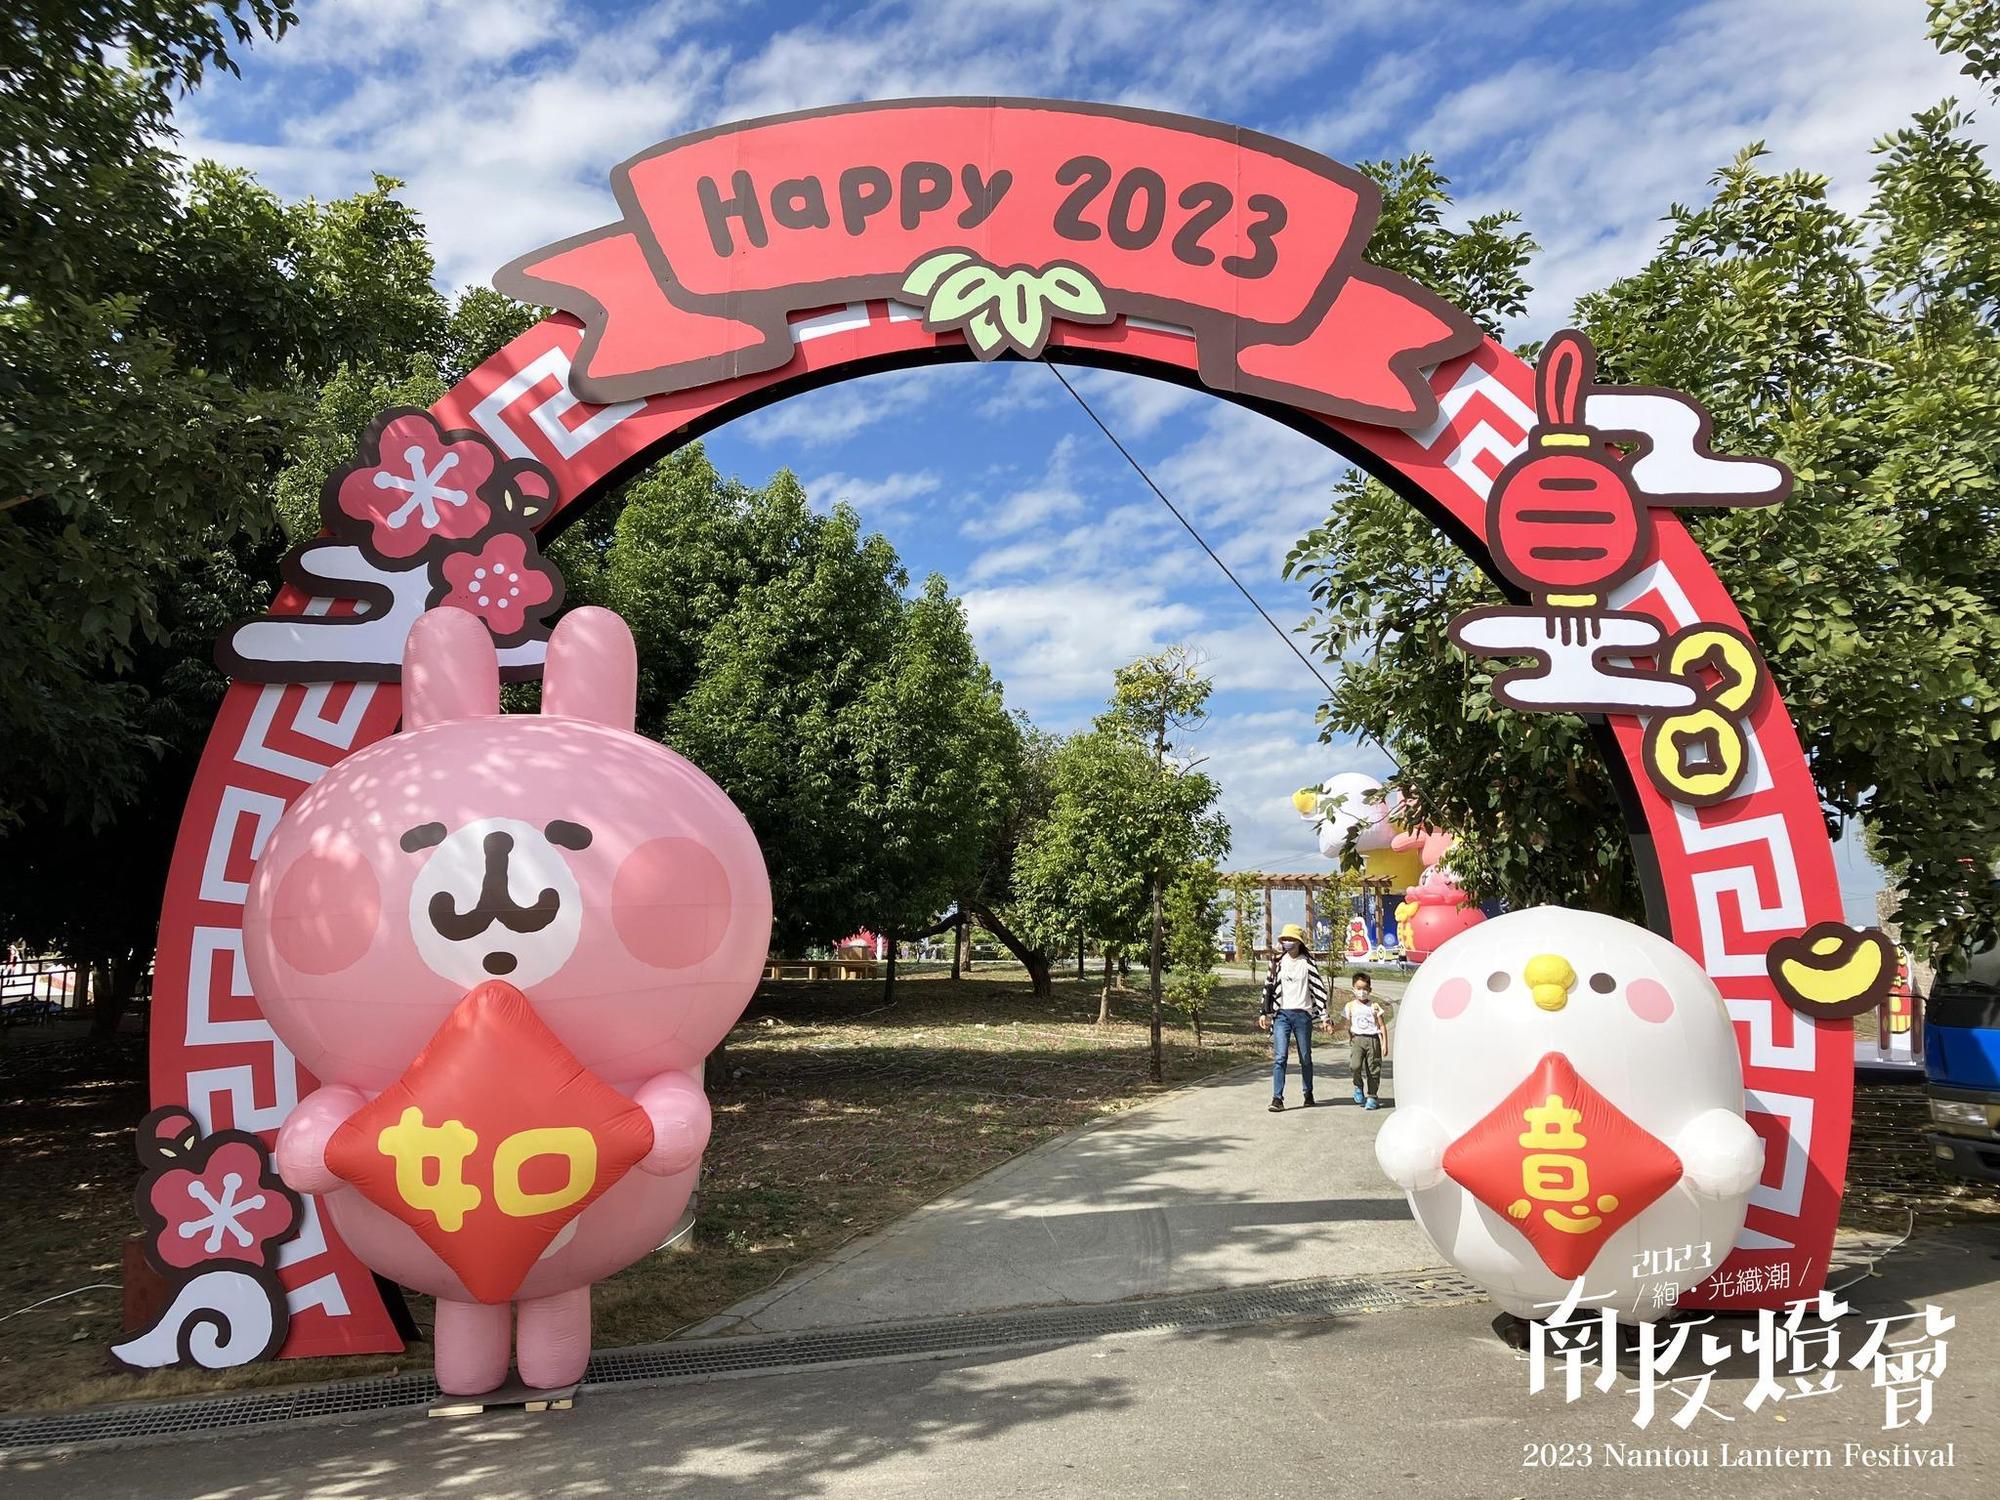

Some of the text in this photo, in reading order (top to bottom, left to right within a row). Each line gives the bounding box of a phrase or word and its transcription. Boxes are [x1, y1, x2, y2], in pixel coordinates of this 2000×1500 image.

[696, 154, 1289, 280] Happy 2023
[377, 1106, 598, 1233] 如
[1508, 1093, 1620, 1235] 意
